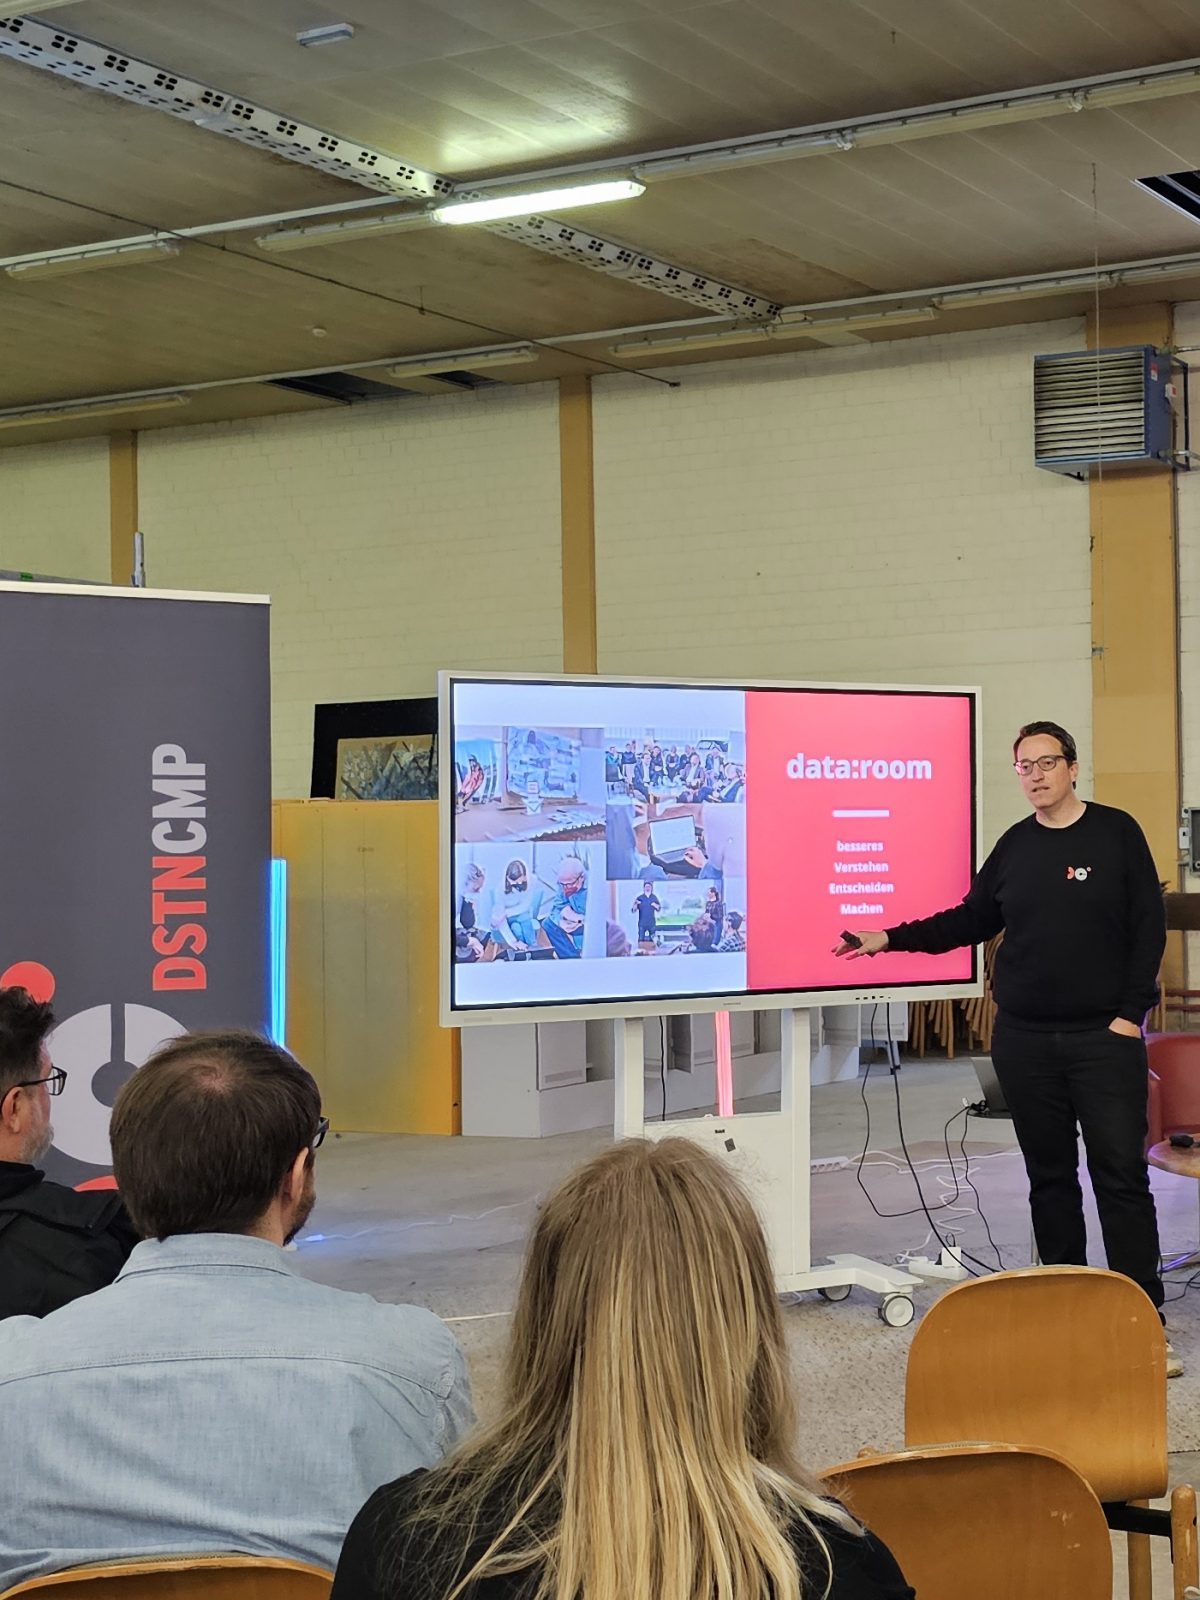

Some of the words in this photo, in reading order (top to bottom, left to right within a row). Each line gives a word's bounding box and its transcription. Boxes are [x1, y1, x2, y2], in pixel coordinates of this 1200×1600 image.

[786, 752, 933, 780] data:room
[836, 840, 884, 852] besseres
[151, 742, 207, 991] DSTNCMP
[834, 861, 889, 873] Verstehen
[829, 881, 894, 894] Entscheiden
[841, 903, 884, 914] Machen
